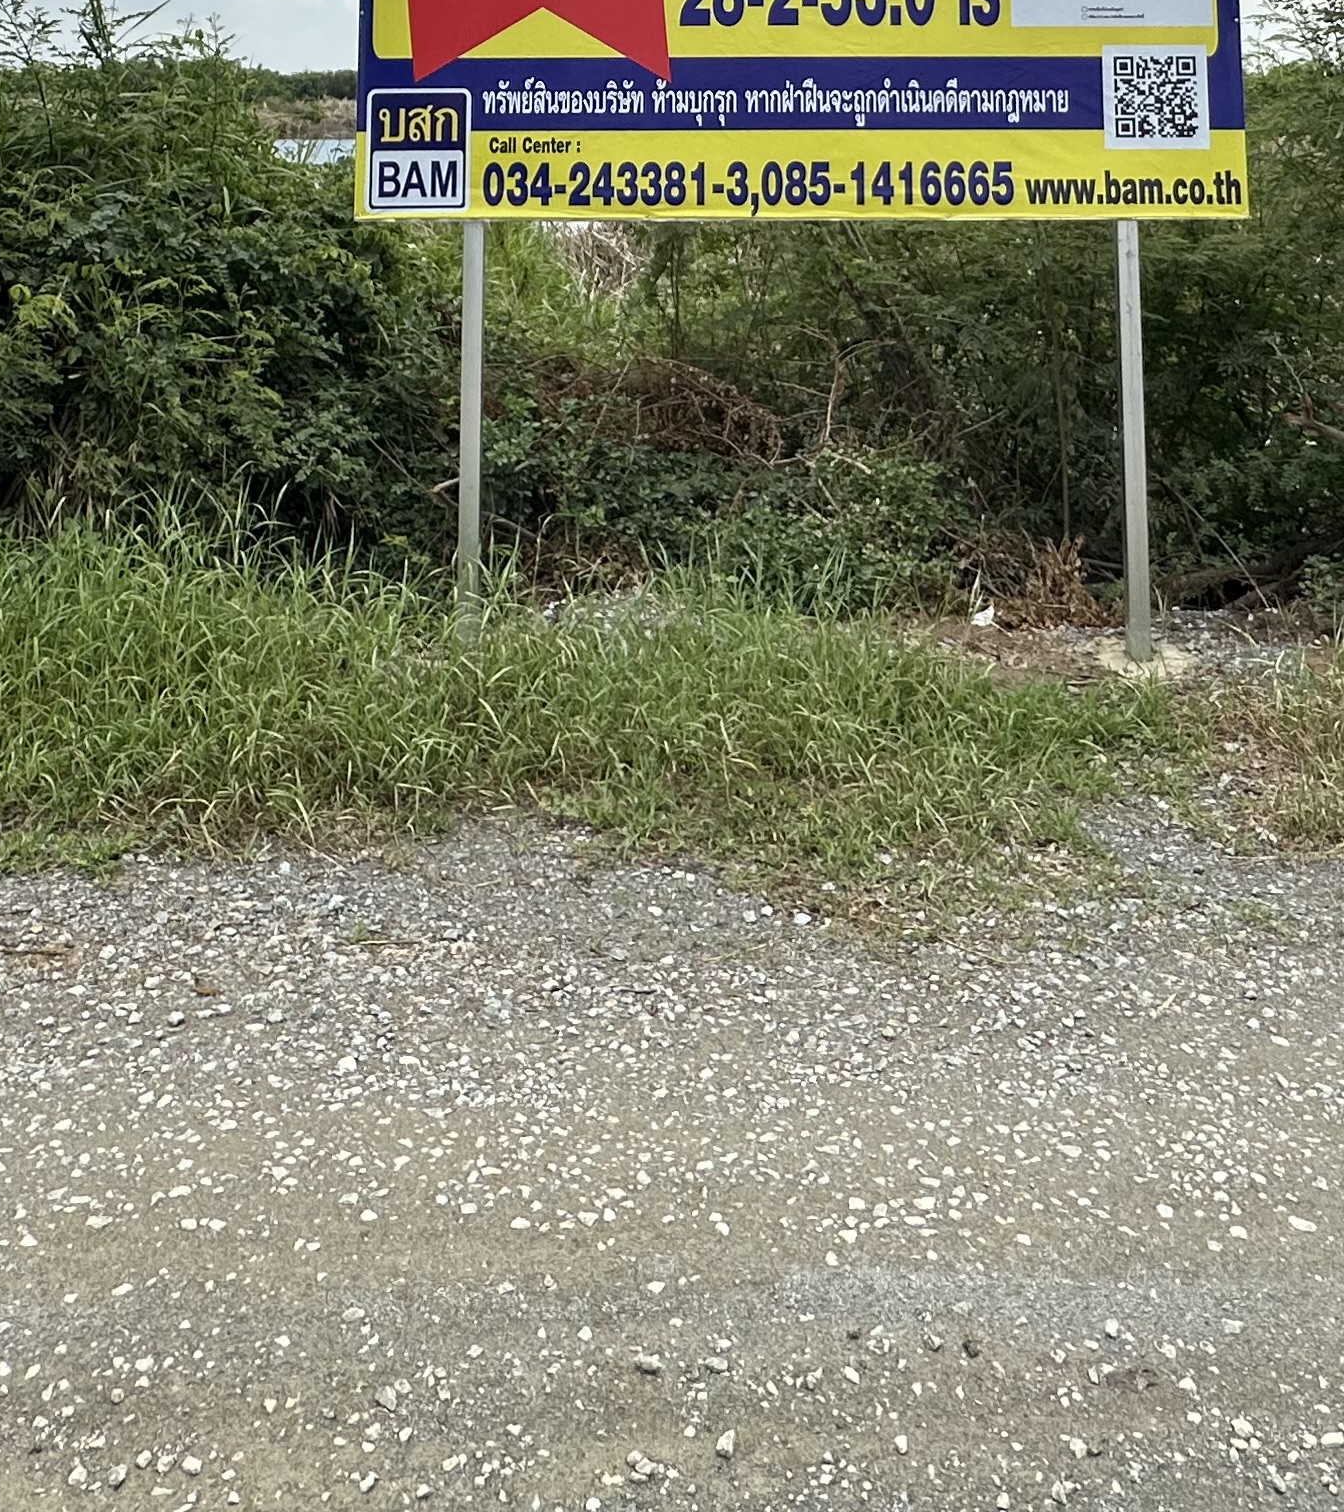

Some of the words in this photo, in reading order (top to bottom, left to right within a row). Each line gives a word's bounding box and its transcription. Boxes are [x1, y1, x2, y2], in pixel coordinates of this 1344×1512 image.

[482, 77, 644, 114] ทรัพย์สินของบริษัท
[651, 79, 738, 127] ห้ามบุกรุก
[379, 105, 459, 143] บสก
[489, 136, 517, 154] Call
[522, 136, 571, 154] Center
[378, 160, 458, 199] BAM
[483, 160, 1014, 217] 034-243381-3,085-1416665
[1025, 170, 1242, 205] www.bam.co.th
